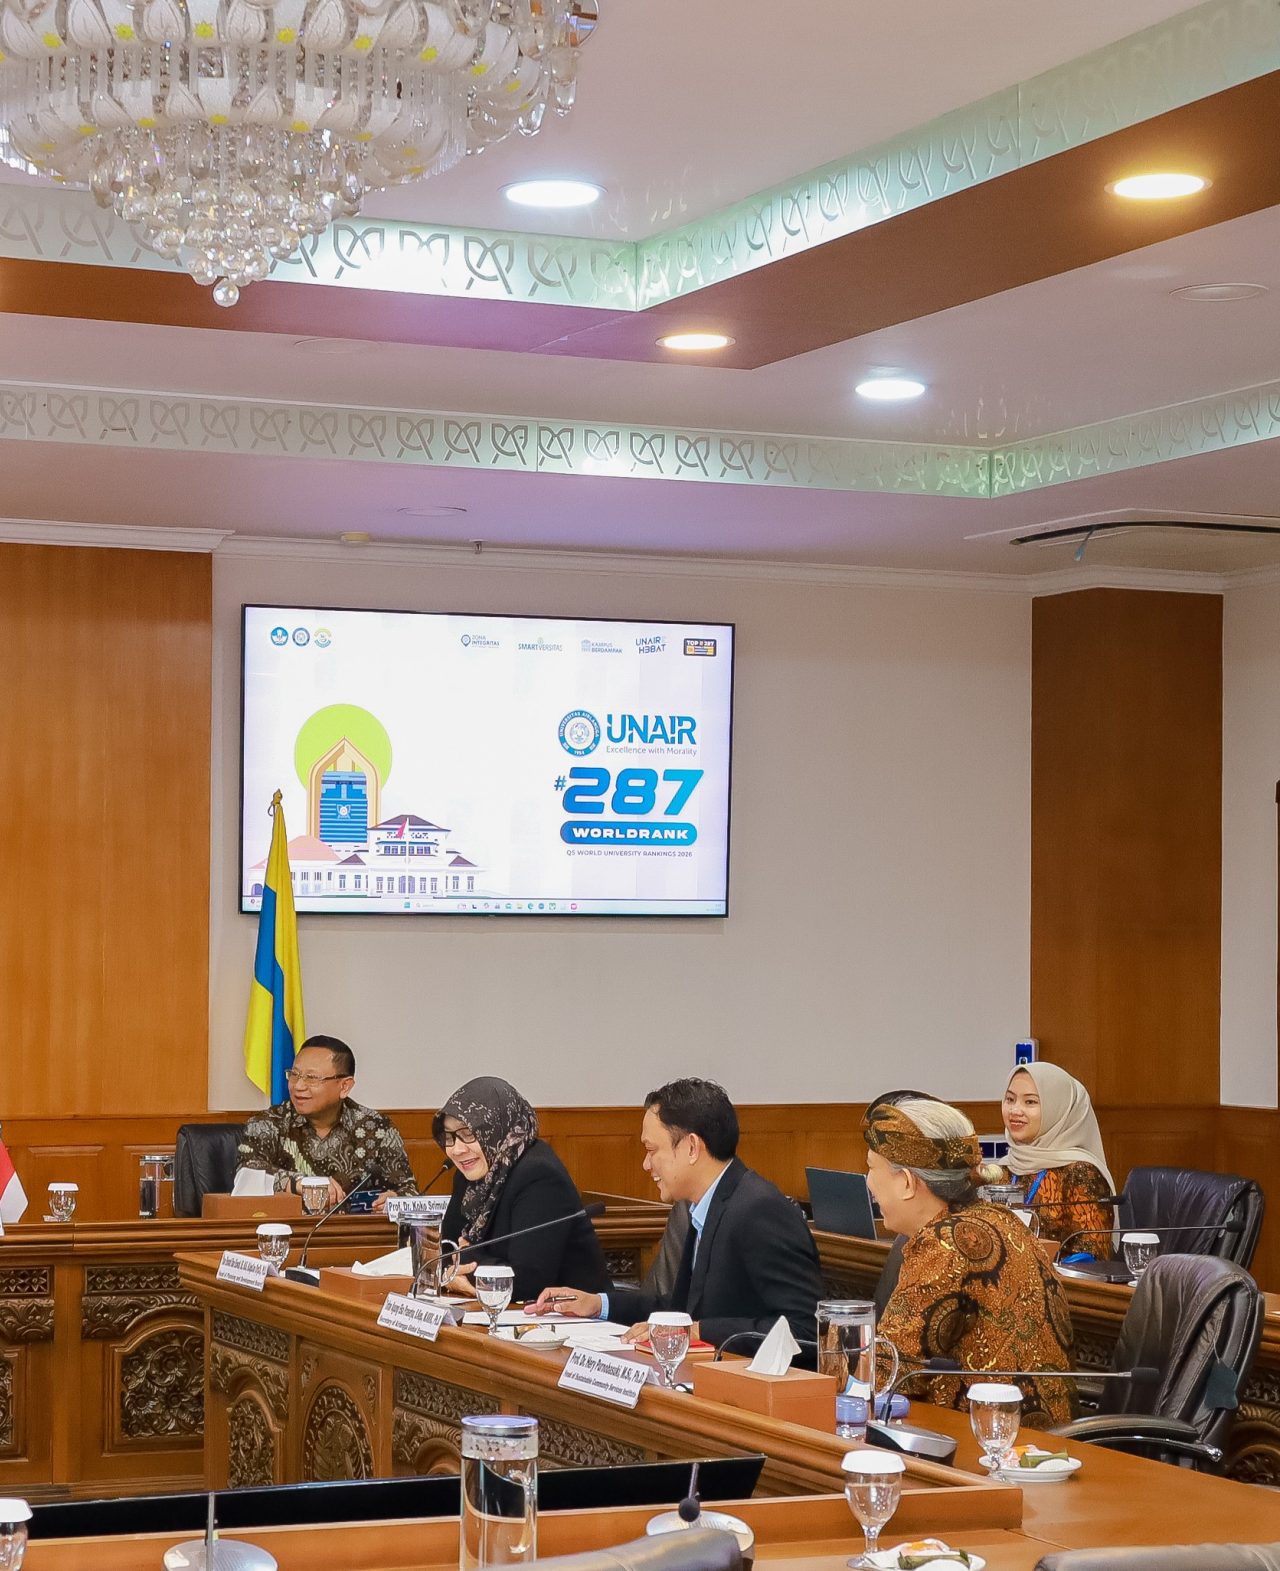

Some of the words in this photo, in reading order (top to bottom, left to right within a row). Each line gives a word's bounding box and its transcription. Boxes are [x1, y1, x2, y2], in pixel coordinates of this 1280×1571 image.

[635, 636, 661, 646] UNAIR
[606, 745, 646, 754] Excellence
[648, 746, 665, 754] with
[666, 747, 697, 757] Morality
[572, 827, 689, 840] WORLDRANK
[566, 849, 576, 857] QS
[403, 1201, 411, 1210] Dr.
[412, 1200, 427, 1210] Koko
